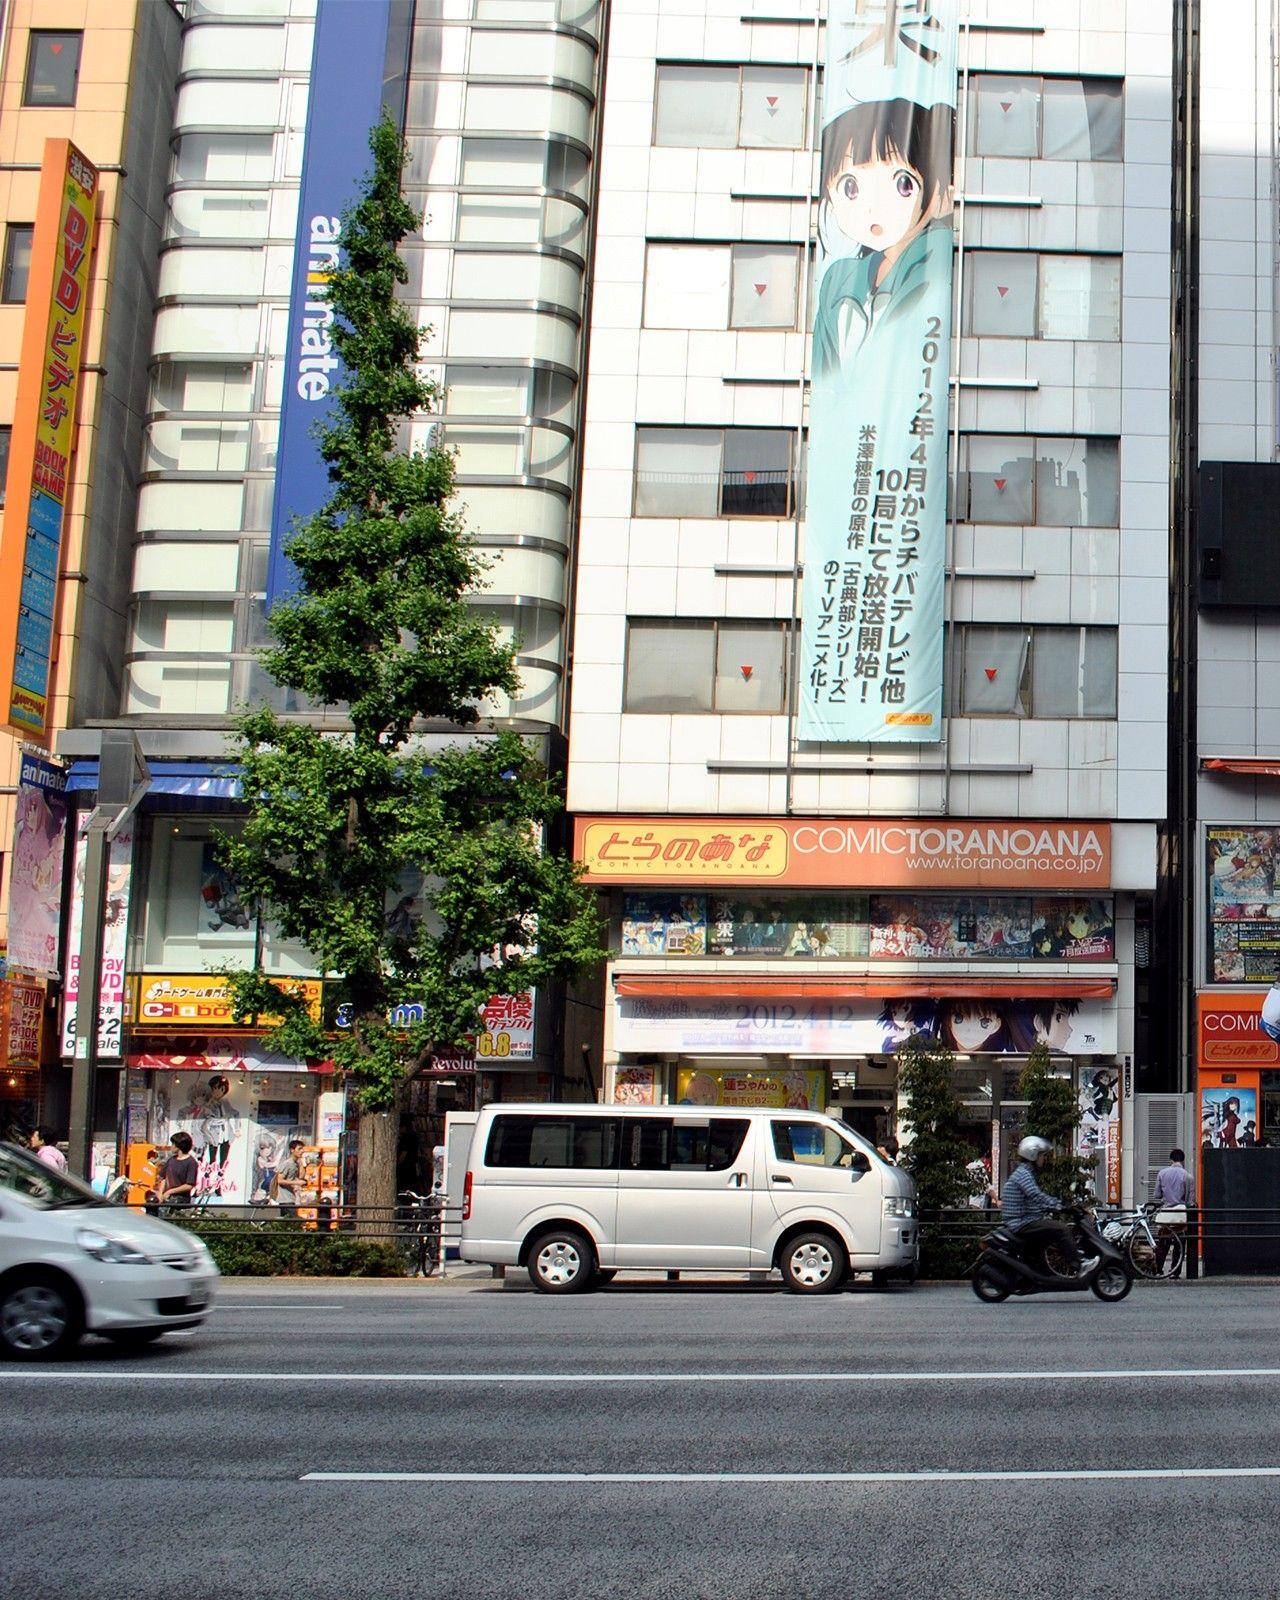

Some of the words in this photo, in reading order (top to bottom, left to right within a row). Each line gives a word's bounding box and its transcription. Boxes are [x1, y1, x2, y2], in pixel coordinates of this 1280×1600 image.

[880, 316, 942, 704] 2012年4月からチバテレビ他
[597, 832, 774, 862] とらのあな
[597, 861, 652, 869] COMIC
[664, 861, 771, 870] TORANOANA
[905, 853, 1104, 873] www.toranoana.co.jp/
[479, 1031, 511, 1057] 6.8
